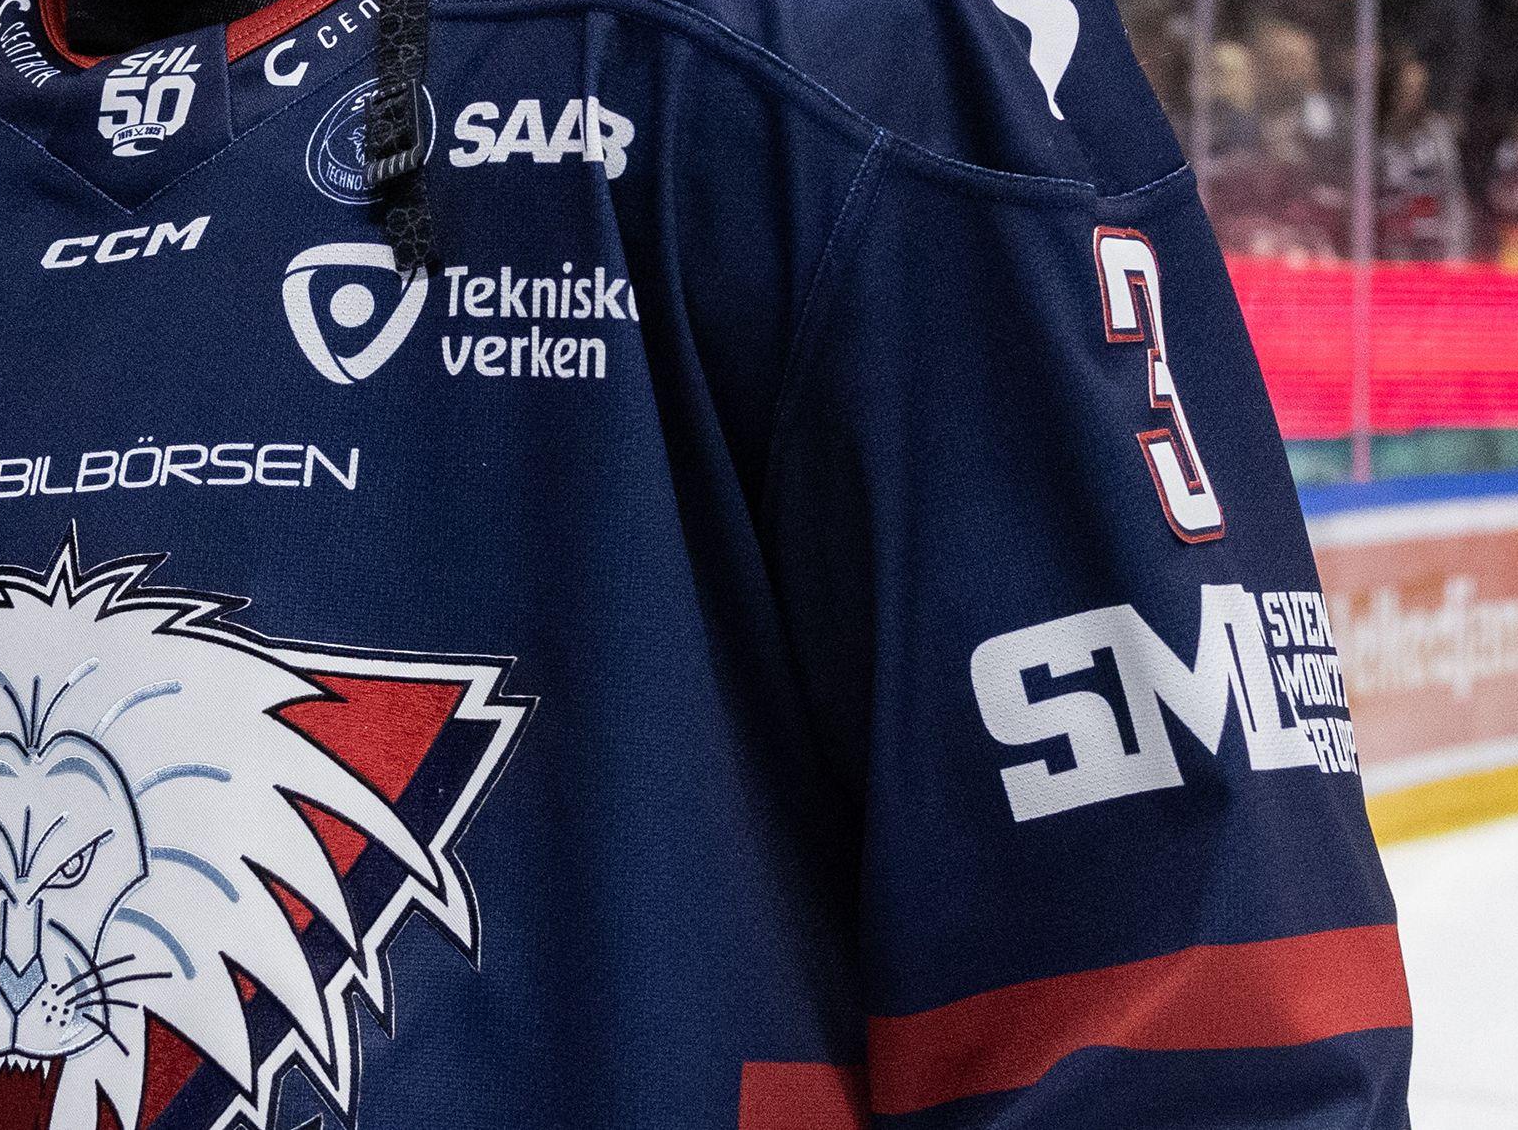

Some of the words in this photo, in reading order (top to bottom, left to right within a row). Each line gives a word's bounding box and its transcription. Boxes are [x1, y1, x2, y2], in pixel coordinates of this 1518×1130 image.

[107, 44, 202, 77] SHL
[97, 74, 197, 139] 50
[448, 95, 637, 179] SAAB
[325, 161, 364, 192] TECHNO
[39, 215, 211, 269] CCM
[441, 326, 607, 380] verken
[1093, 225, 1226, 545] 3
[1261, 591, 1334, 648] SVEN
[1271, 653, 1350, 708] MONT
